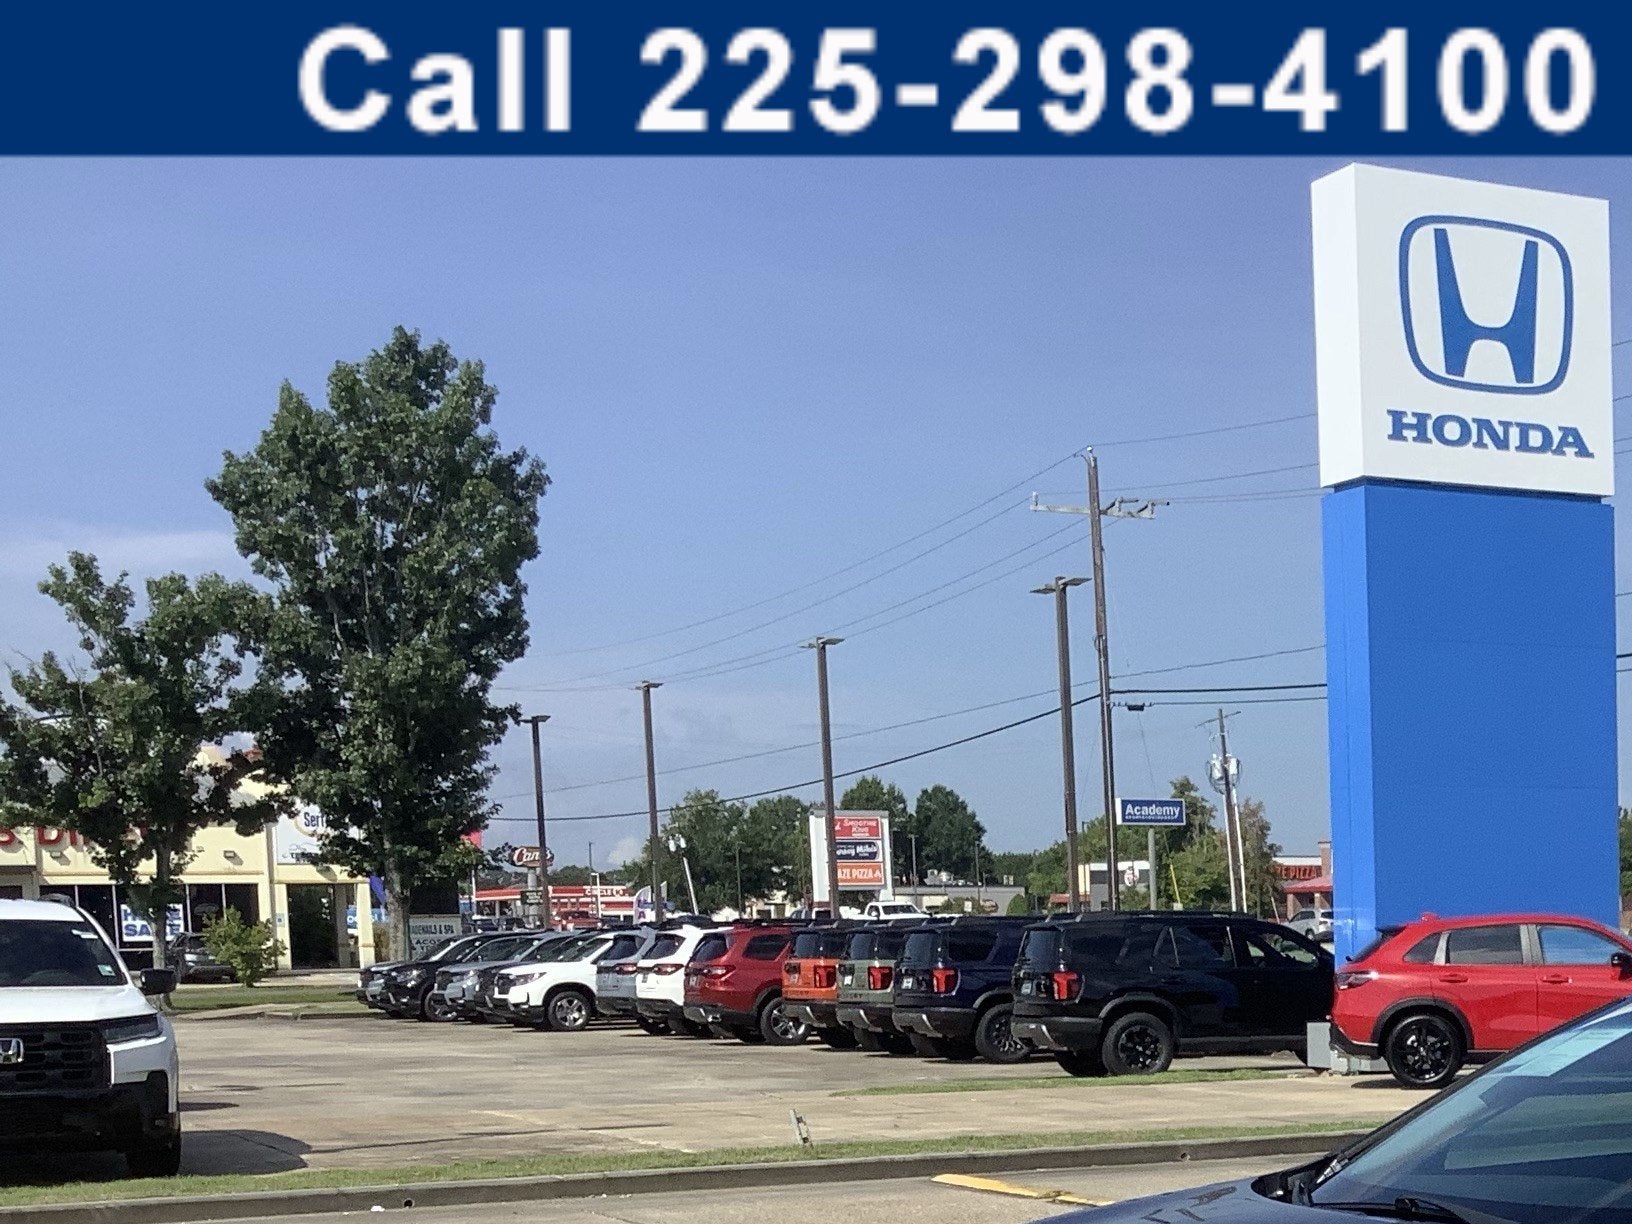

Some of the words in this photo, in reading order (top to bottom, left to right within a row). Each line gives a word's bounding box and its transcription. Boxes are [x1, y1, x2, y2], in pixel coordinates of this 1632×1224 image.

[1386, 408, 1595, 459] HONDA
[1125, 803, 1180, 819] Academy
[303, 811, 326, 828] Sert
[851, 868, 873, 880] PIZZA
[124, 923, 180, 937] SAE
